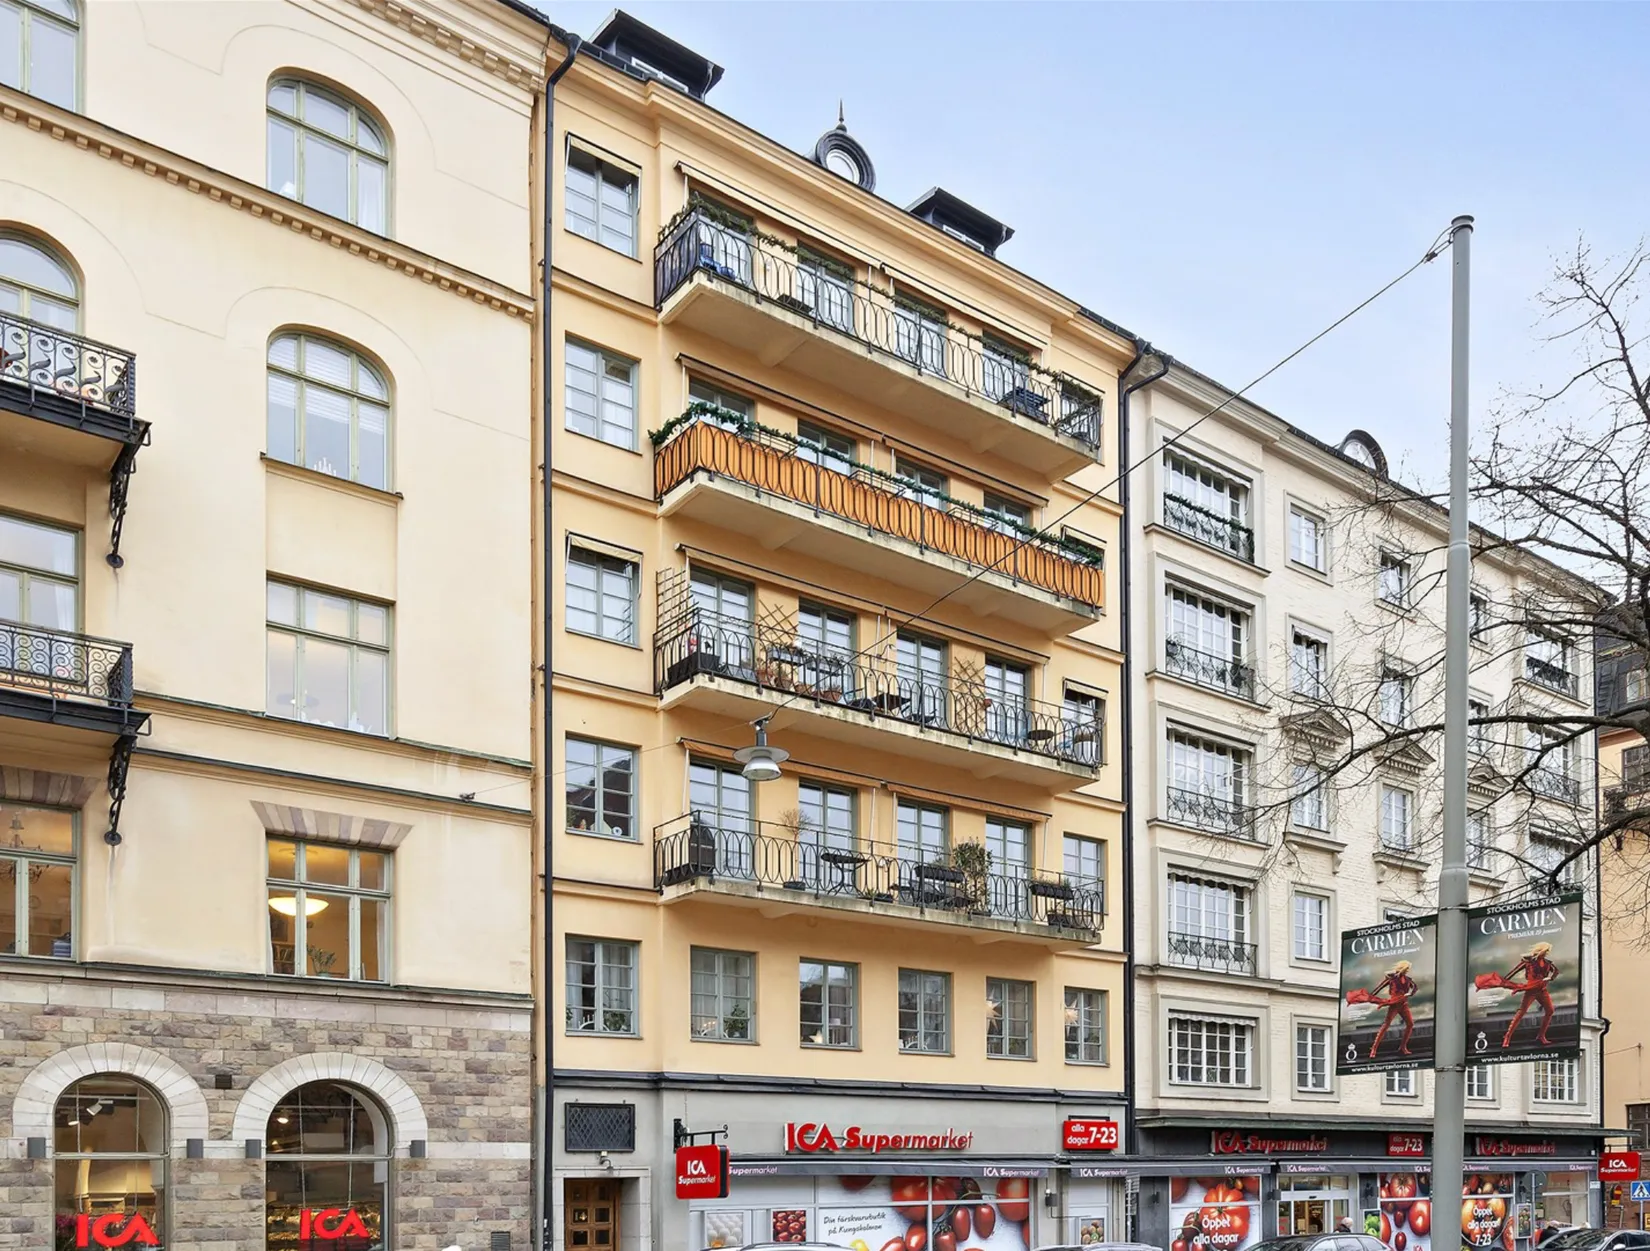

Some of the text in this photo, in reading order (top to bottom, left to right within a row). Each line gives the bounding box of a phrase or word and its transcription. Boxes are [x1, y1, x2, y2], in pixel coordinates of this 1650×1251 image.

[1487, 896, 1562, 915] STOCKHOLMS STAD
[1480, 905, 1568, 935] CARMEN
[1357, 919, 1420, 937] STOCKHOLMS STAD
[1351, 927, 1424, 955] CARMEN
[1071, 1123, 1085, 1132] alla
[784, 1122, 973, 1153] ICA Supermarket
[1067, 1135, 1089, 1146] dagar
[1088, 1126, 1117, 1144] 7-23
[1211, 1130, 1247, 1154] ICA
[1404, 1138, 1423, 1152] 7-23
[687, 1160, 706, 1175] ICA
[1224, 1166, 1236, 1175] ICA
[1287, 1164, 1298, 1173] ICA
[1609, 1159, 1627, 1168] ICA
[678, 1174, 716, 1185] Supermarket
[983, 1167, 1040, 1178] ICA Supermarket
[1080, 1168, 1094, 1177] ICA
[300, 1208, 371, 1241] ICA
[823, 1216, 836, 1225] Din
[1201, 1214, 1231, 1230] Öppet
[75, 1213, 160, 1248] ICA
[827, 1227, 838, 1237] på
[1192, 1232, 1240, 1246] alla dagar
[1475, 1233, 1492, 1246] 7-23
